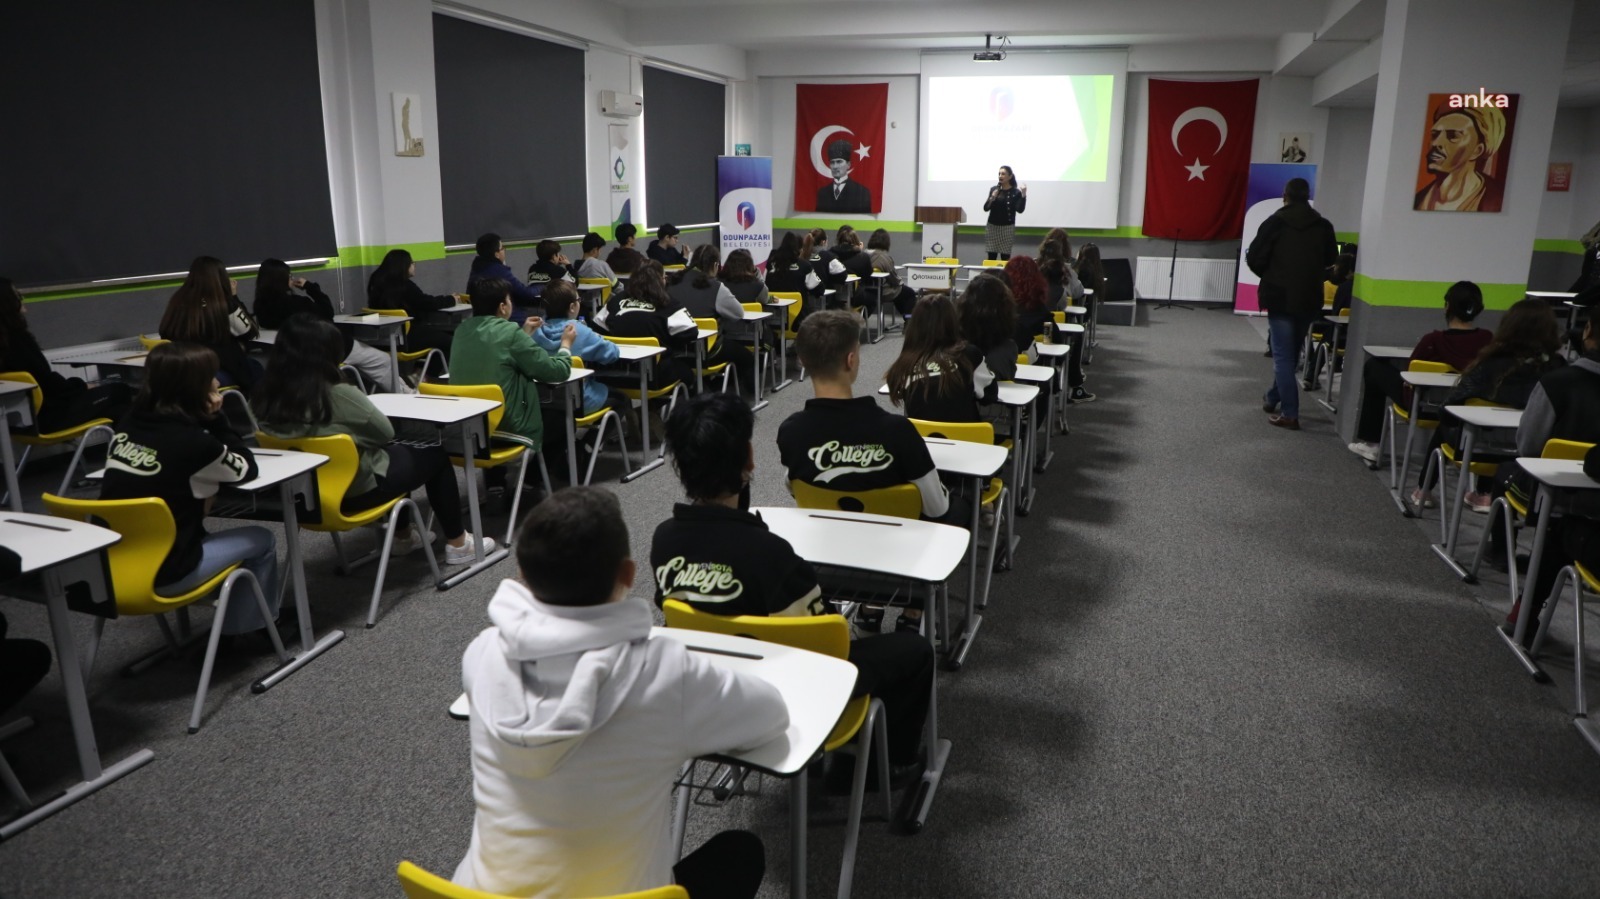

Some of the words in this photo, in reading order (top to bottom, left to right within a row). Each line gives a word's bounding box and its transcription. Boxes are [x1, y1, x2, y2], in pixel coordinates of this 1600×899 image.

[107, 432, 156, 467] College
[807, 440, 887, 471] College
[656, 556, 734, 596] College
